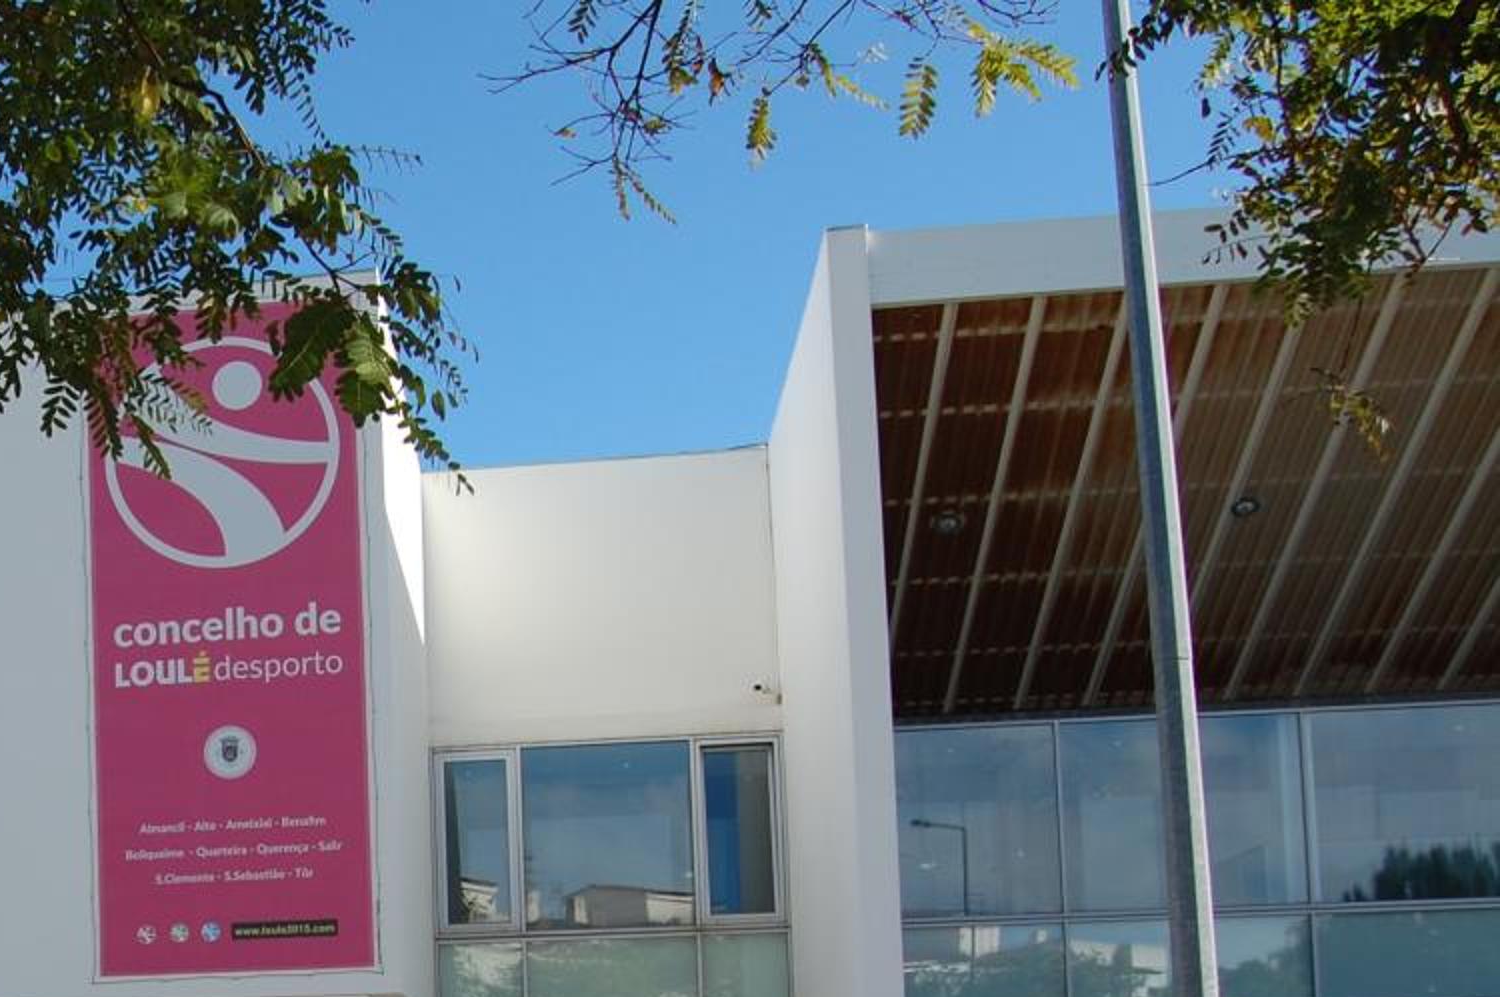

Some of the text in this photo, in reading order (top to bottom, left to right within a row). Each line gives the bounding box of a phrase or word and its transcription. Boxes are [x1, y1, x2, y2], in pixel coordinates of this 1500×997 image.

[113, 601, 342, 647] concelho de
[115, 650, 344, 689] LOULÉ desporto
